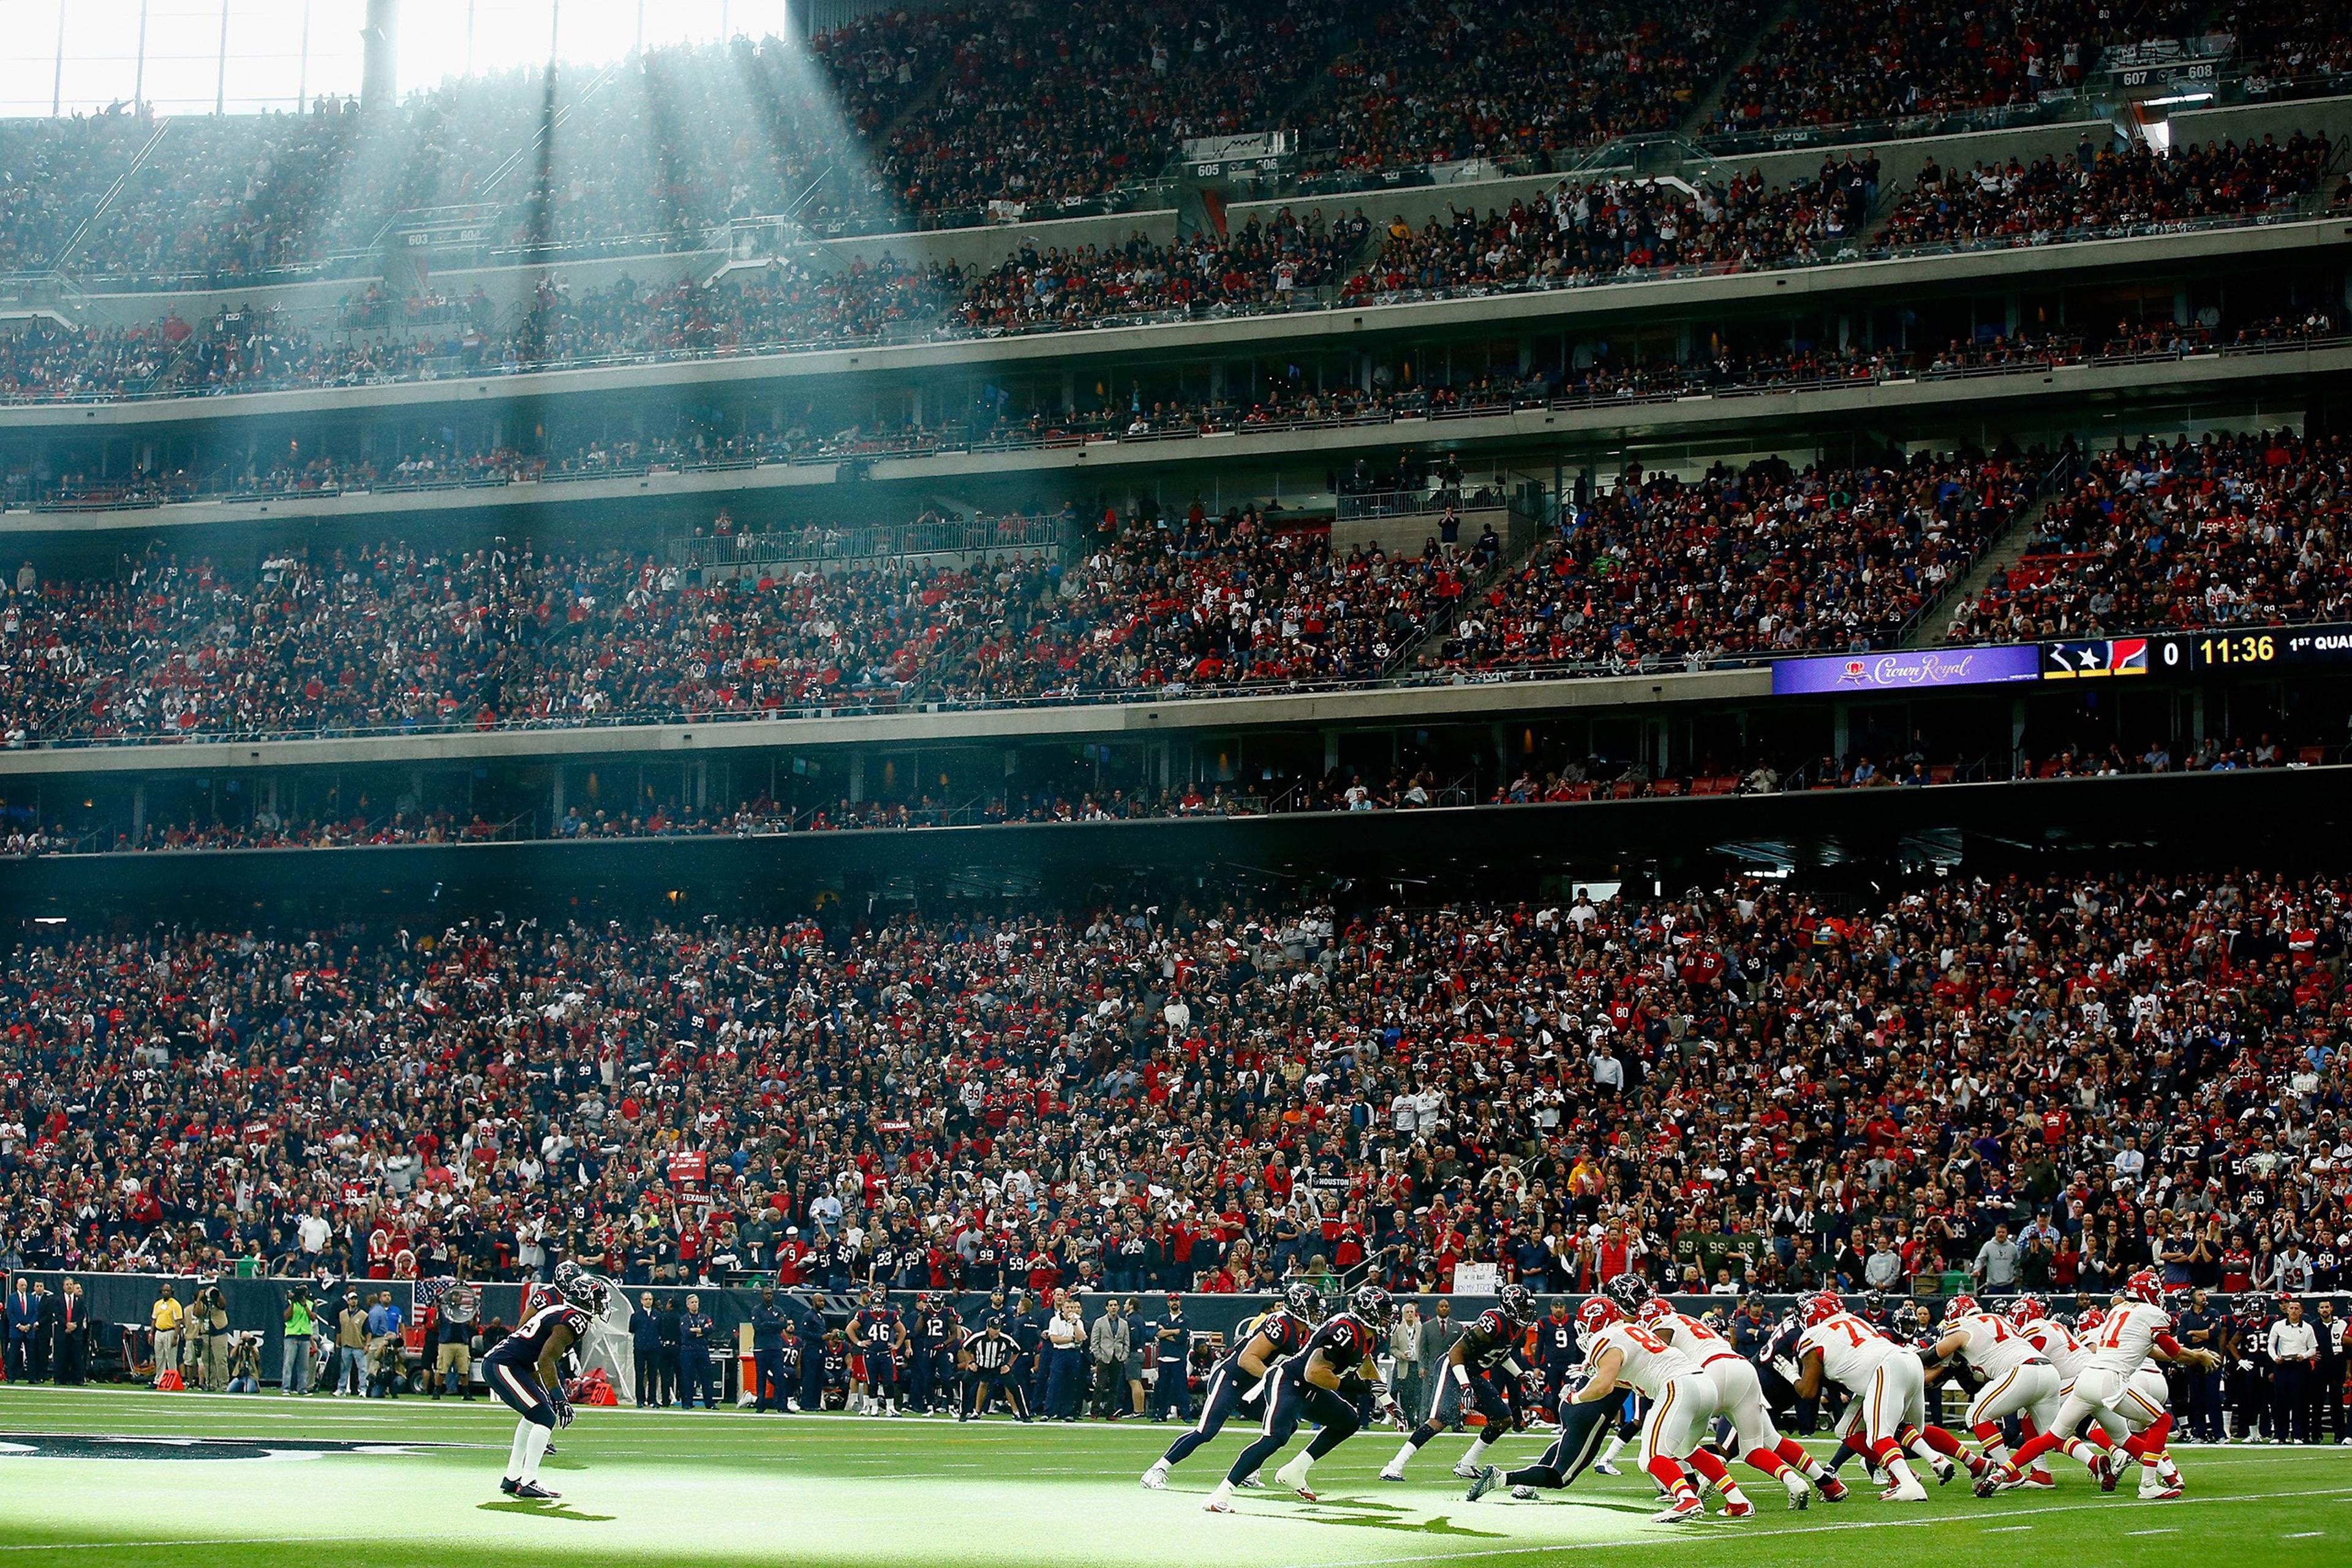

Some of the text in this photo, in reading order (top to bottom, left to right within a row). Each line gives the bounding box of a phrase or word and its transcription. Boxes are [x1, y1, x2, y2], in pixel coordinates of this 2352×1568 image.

[2099, 10, 2109, 18] 80
[2188, 66, 2212, 78] 608
[2124, 72, 2147, 85] 607
[1198, 164, 1219, 176] 605
[409, 234, 428, 245] 603
[2243, 483, 2254, 492] 99
[2253, 495, 2263, 503] 23
[2206, 523, 2218, 533] 58
[644, 568, 655, 577] 99
[2247, 577, 2257, 587] 99
[1244, 589, 1254, 599] 80
[1300, 585, 1310, 594] 90
[1889, 611, 1900, 622] 99
[1375, 643, 1387, 652] 99
[2290, 635, 2352, 651] 1ST QUA
[2164, 643, 2178, 665] 0
[2201, 636, 2274, 663] 11:36
[1874, 655, 1972, 684] Crown Royal
[31, 722, 39, 730] 10
[998, 941, 1012, 950] 99
[1747, 959, 1760, 969] 99
[1616, 1008, 1628, 1017] 80
[2141, 1001, 2154, 1012] 99
[2087, 1010, 2098, 1020] 56
[691, 1017, 704, 1028] 99
[132, 1069, 146, 1081] 99
[579, 1066, 591, 1076] 99
[2238, 1068, 2250, 1077] 23
[968, 1089, 980, 1100] 99
[753, 1110, 763, 1118] 9
[246, 1122, 269, 1134] TEXANS
[2047, 1118, 2061, 1126] 25
[481, 1127, 495, 1137] 99
[1719, 1150, 1731, 1161] 23
[344, 1189, 358, 1199] 99
[681, 1194, 709, 1203] TEXANS
[2250, 1191, 2264, 1204] 56
[1678, 1240, 1694, 1253] 99
[1709, 1242, 1726, 1254] 99
[1738, 1242, 1754, 1254] 99
[837, 1247, 851, 1263] 56
[905, 1253, 919, 1268] 99
[979, 1251, 993, 1261] 99
[1009, 1258, 1023, 1269] 59
[2285, 1268, 2304, 1284] 59
[532, 1294, 546, 1309] 27
[568, 1314, 587, 1334] 25
[927, 1320, 943, 1335] 12
[1479, 1316, 1495, 1334] 55
[1677, 1315, 1716, 1340] 8
[1978, 1315, 2020, 1343] 7
[869, 1324, 888, 1341] 46
[1264, 1321, 1282, 1340] 56
[2099, 1311, 2132, 1351] 11
[1332, 1327, 1353, 1348] 51
[1555, 1330, 1568, 1348] 9
[1624, 1326, 1668, 1354] 8
[2050, 1323, 2079, 1352] 7
[2247, 1335, 2267, 1352] 35
[784, 1348, 799, 1364] 78
[824, 1357, 842, 1369] 63
[160, 1374, 173, 1387] 20
[590, 1386, 606, 1403] 30
